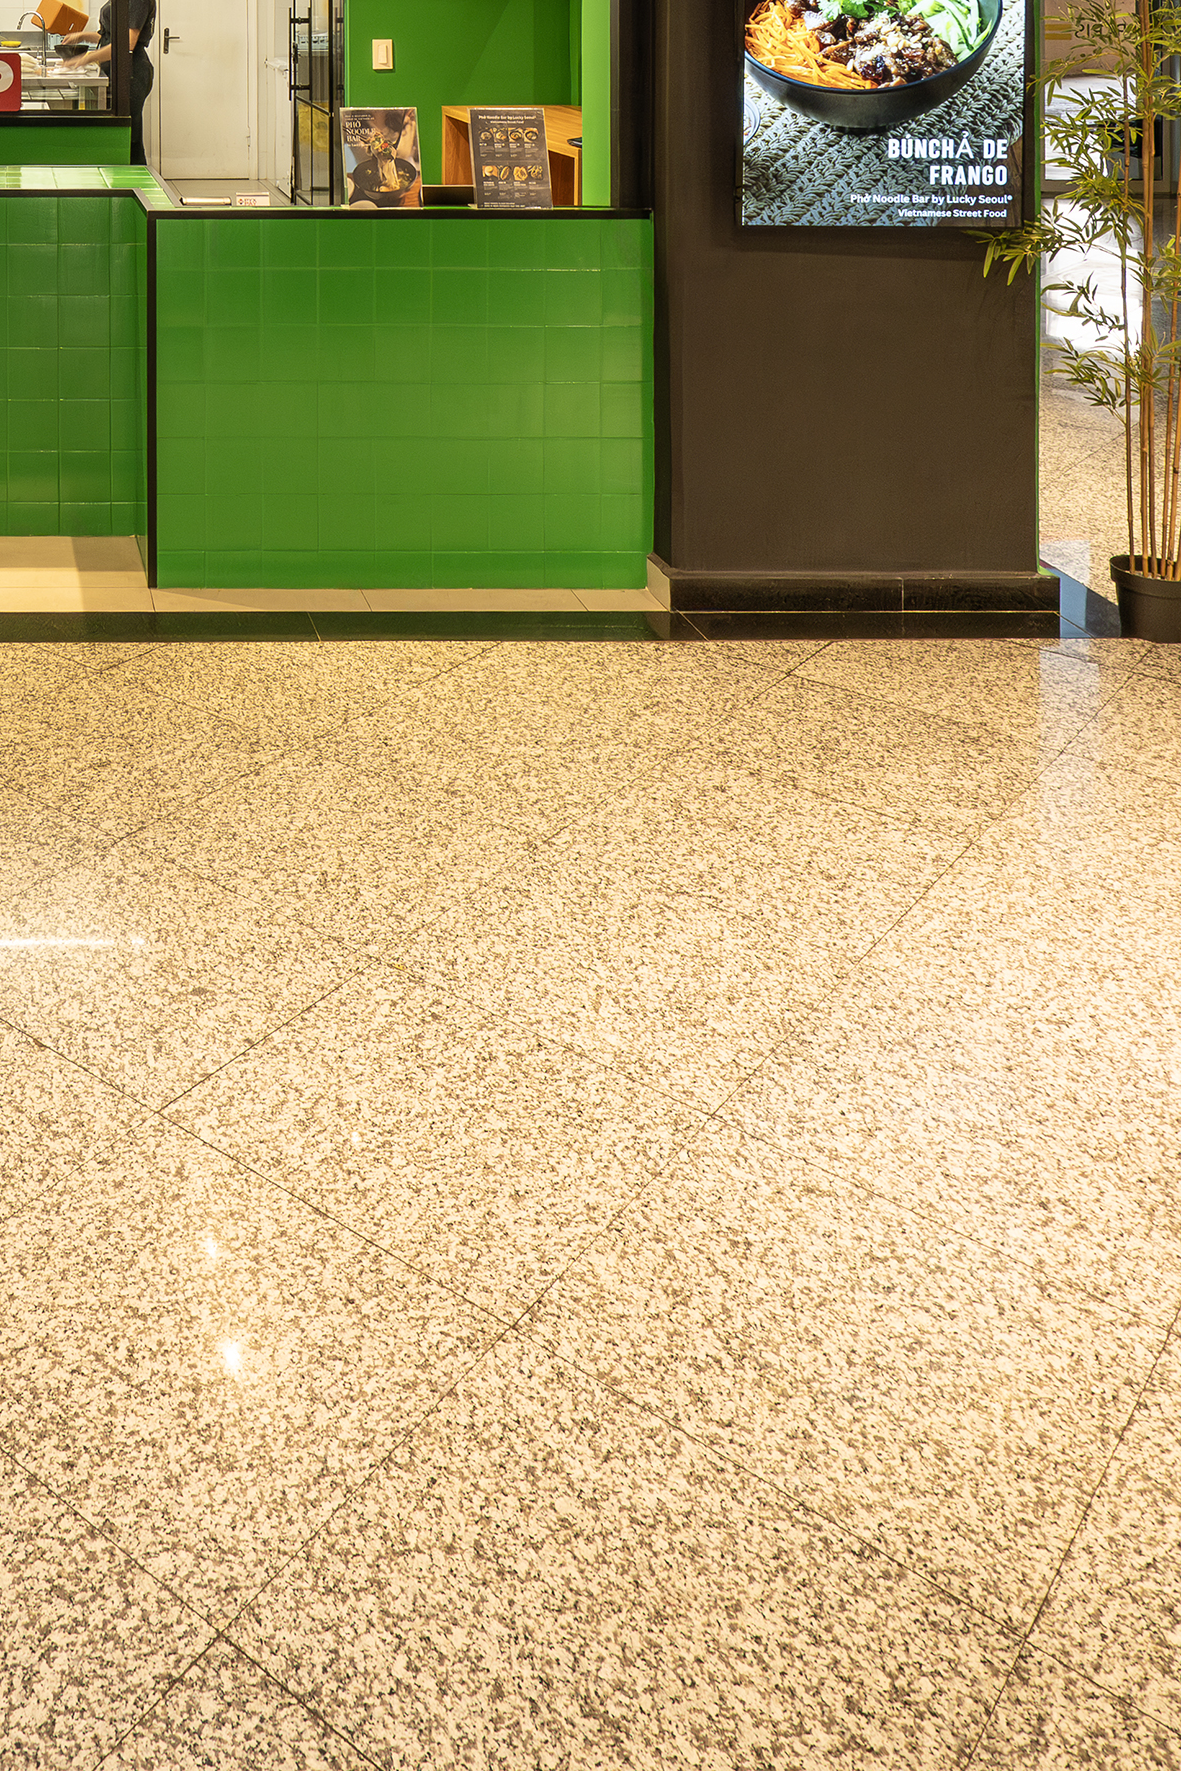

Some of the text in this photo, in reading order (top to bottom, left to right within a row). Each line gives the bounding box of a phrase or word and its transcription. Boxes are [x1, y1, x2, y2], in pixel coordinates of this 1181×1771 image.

[983, 139, 1008, 159] DE
[929, 165, 1008, 186] FRANGO
[873, 194, 910, 204] Noodle
[912, 195, 929, 204] Bar
[932, 194, 945, 206] by
[947, 195, 977, 206] Lucky
[898, 209, 1007, 218] Vietnamese Street Food
